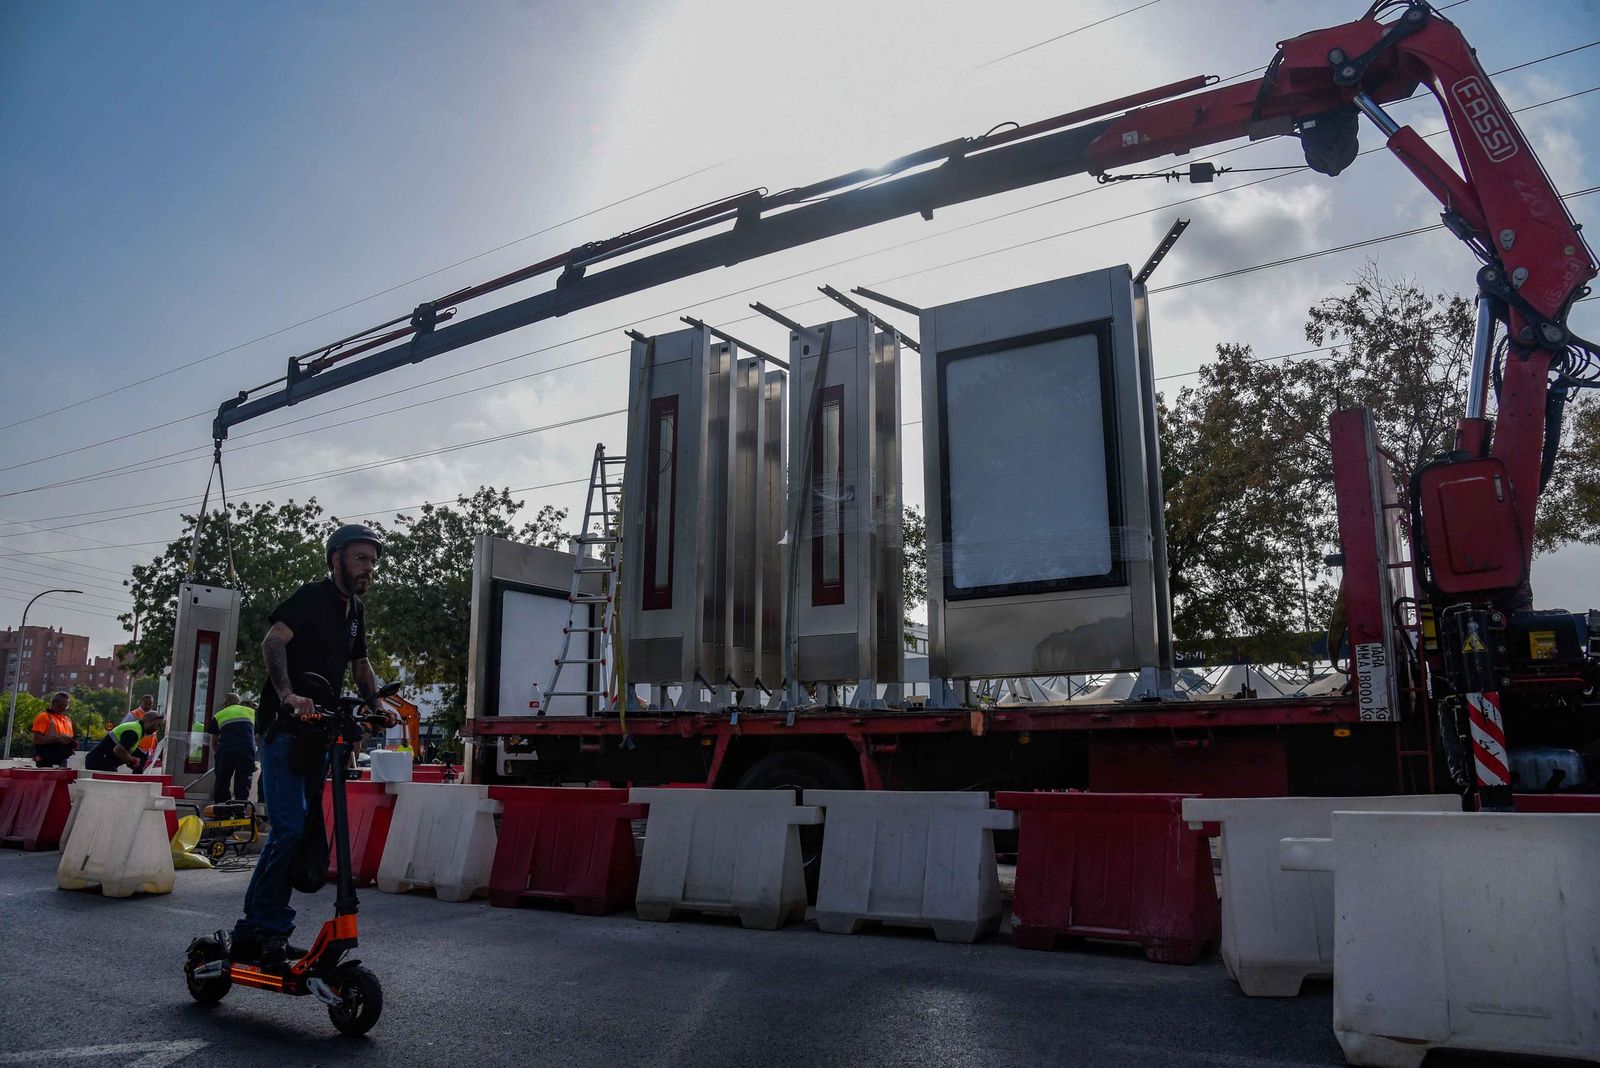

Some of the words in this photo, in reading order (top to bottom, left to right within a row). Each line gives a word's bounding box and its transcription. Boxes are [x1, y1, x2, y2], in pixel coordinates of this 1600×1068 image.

[1457, 82, 1512, 157] FASSI
[1357, 645, 1370, 669] MMA
[1371, 646, 1385, 668] TARA
[1359, 671, 1373, 704] 18000
[1361, 707, 1375, 720] Kg
[1375, 707, 1389, 720] Kg
